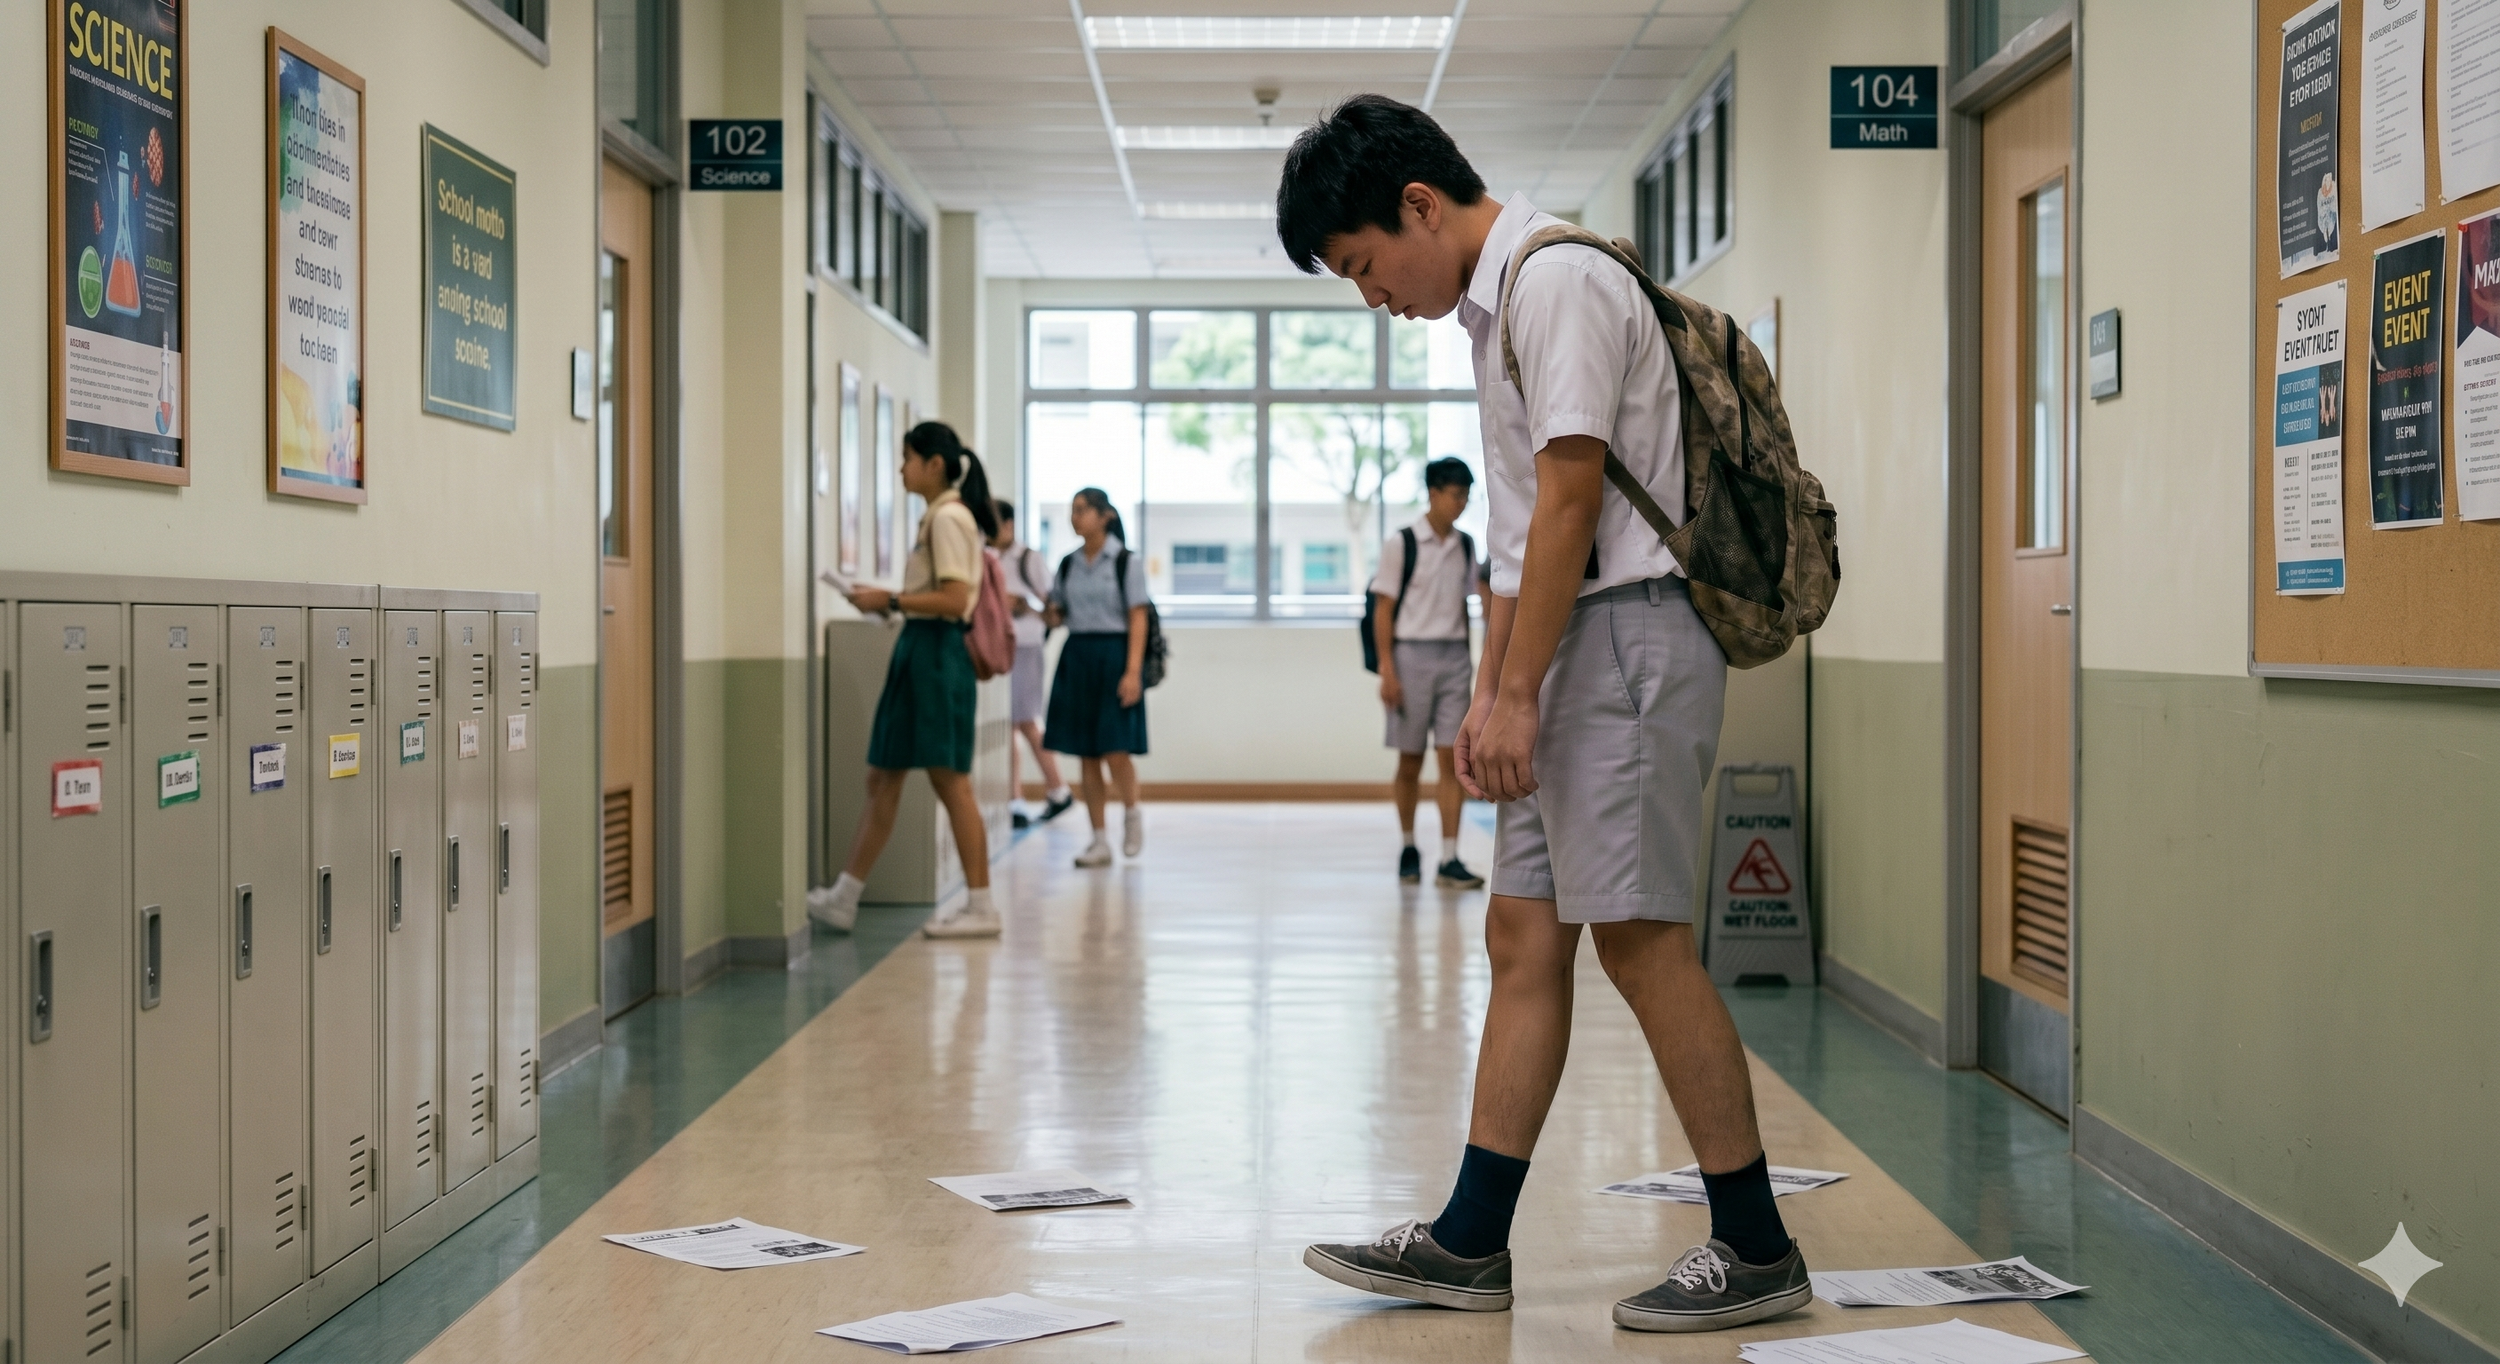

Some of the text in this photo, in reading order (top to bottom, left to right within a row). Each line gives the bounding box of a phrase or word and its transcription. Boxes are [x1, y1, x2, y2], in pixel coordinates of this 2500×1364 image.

[69, 2, 173, 100] SCIENCE
[1850, 73, 1918, 108] 104
[706, 125, 767, 156] 102
[1859, 122, 1909, 141] Math
[286, 175, 304, 200] and
[701, 166, 771, 186] Science
[438, 177, 505, 241] School motto
[299, 219, 316, 243] and
[452, 234, 462, 268] is
[333, 265, 342, 291] to
[2384, 270, 2431, 313] EVENT
[473, 293, 507, 332] school
[2384, 307, 2430, 349] EVENT
[1725, 815, 1792, 830] CAUTION
[1755, 914, 1798, 928] FLOOR
